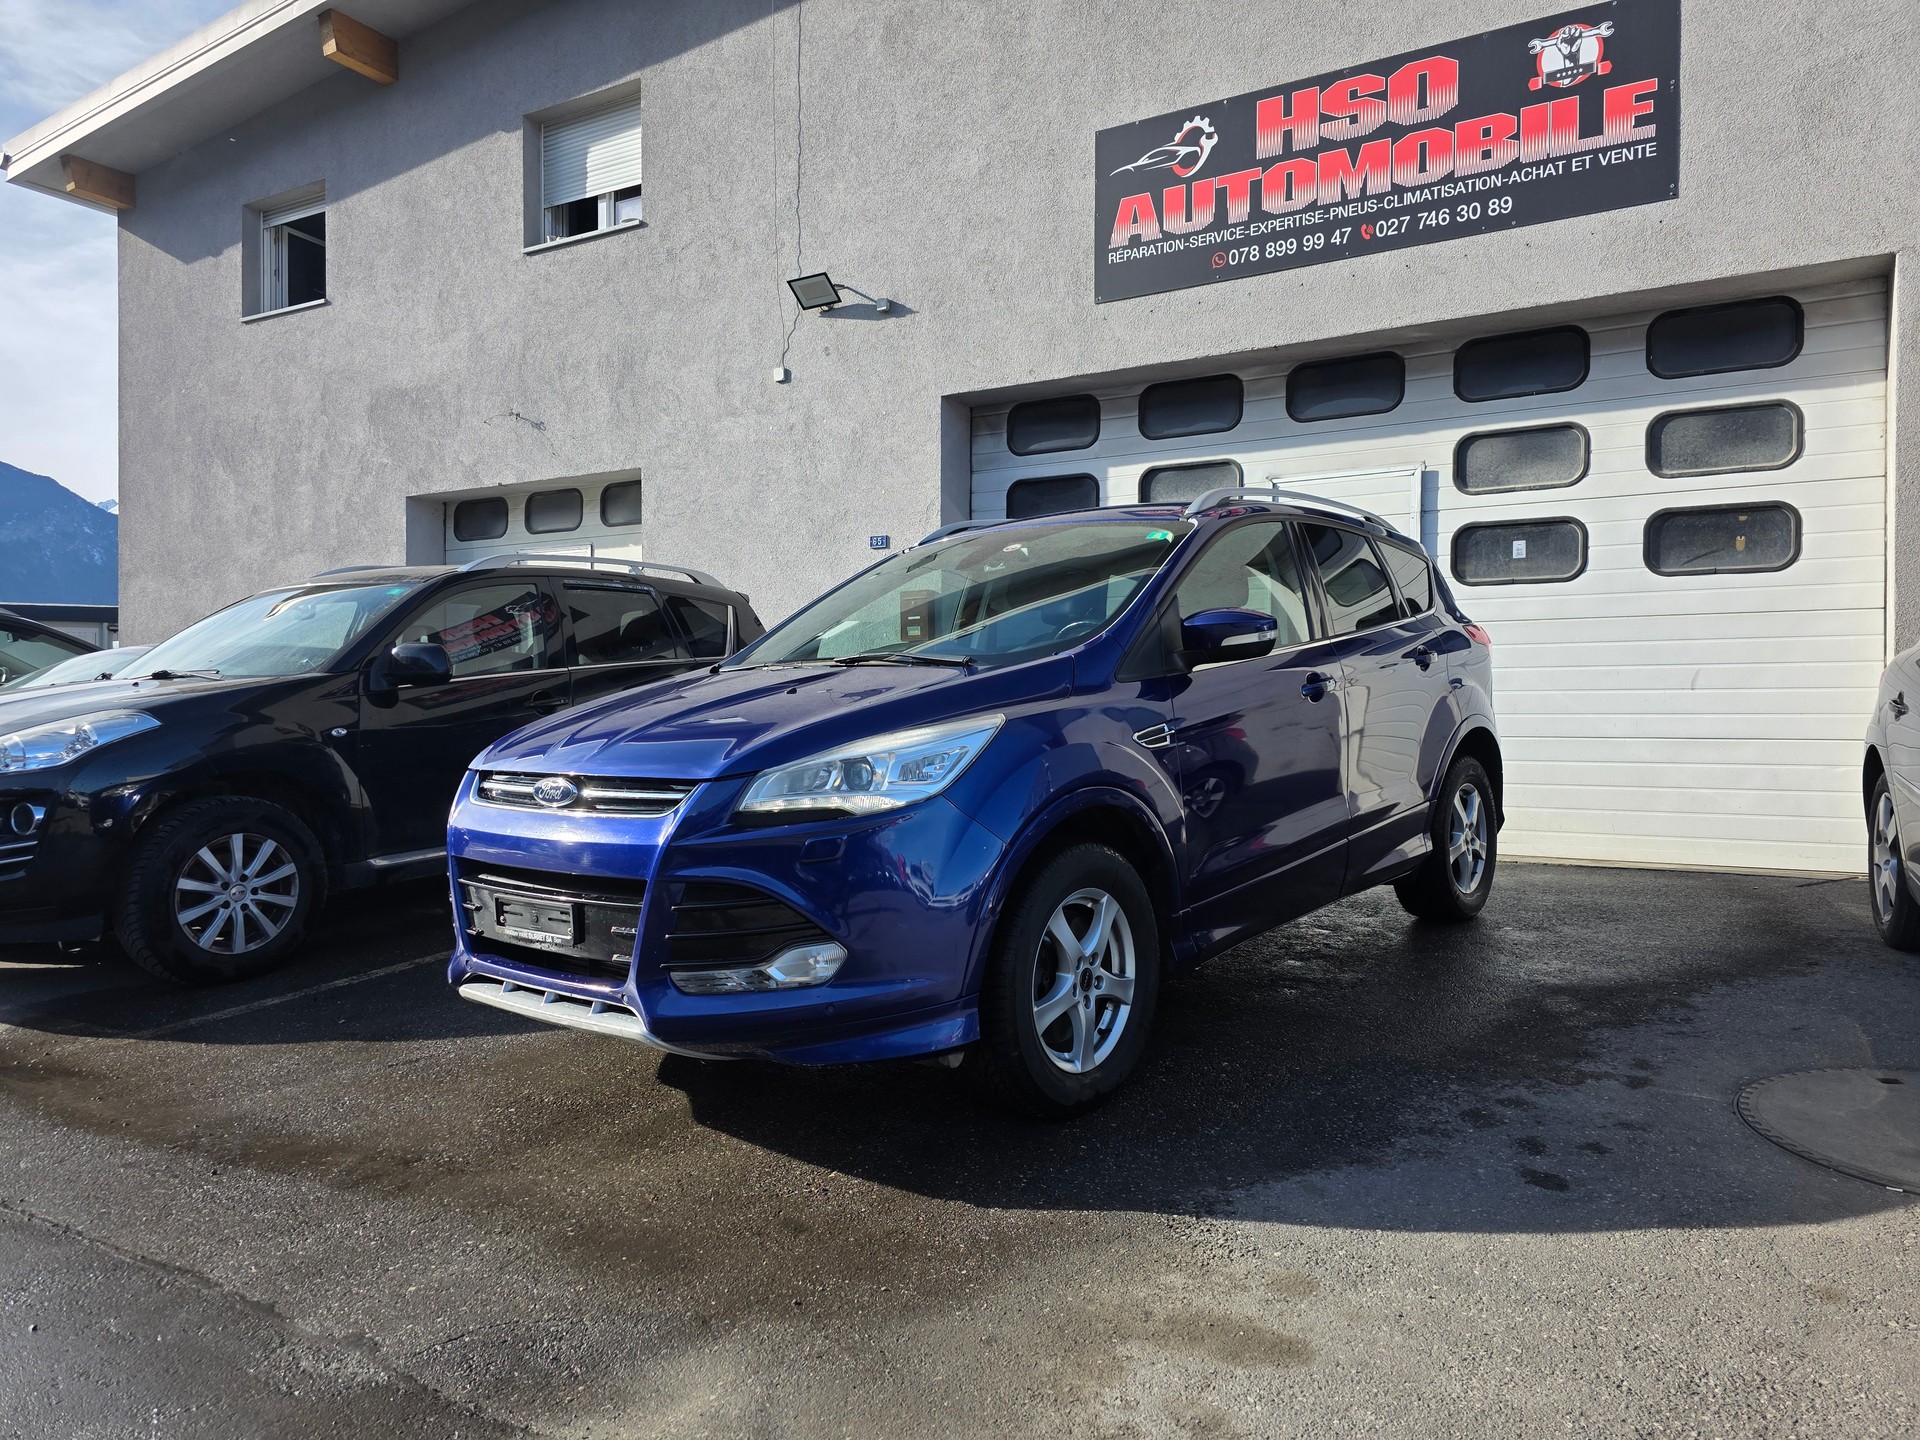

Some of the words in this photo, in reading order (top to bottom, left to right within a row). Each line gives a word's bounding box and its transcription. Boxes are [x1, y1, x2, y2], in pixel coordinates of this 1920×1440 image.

[1256, 56, 1459, 160] HSO
[1108, 78, 1659, 249] AUTOMOBILE
[1571, 154, 1594, 171] ET
[1598, 142, 1658, 166] VENTE
[1375, 217, 1411, 239] 027
[1417, 207, 1451, 230] 746
[1456, 201, 1482, 222] 30
[1487, 196, 1513, 216] 89
[1228, 245, 1260, 266] 078
[1265, 238, 1298, 259] 899
[1302, 232, 1325, 252] 99
[1330, 228, 1353, 246] 47
[538, 781, 564, 800] Ford
